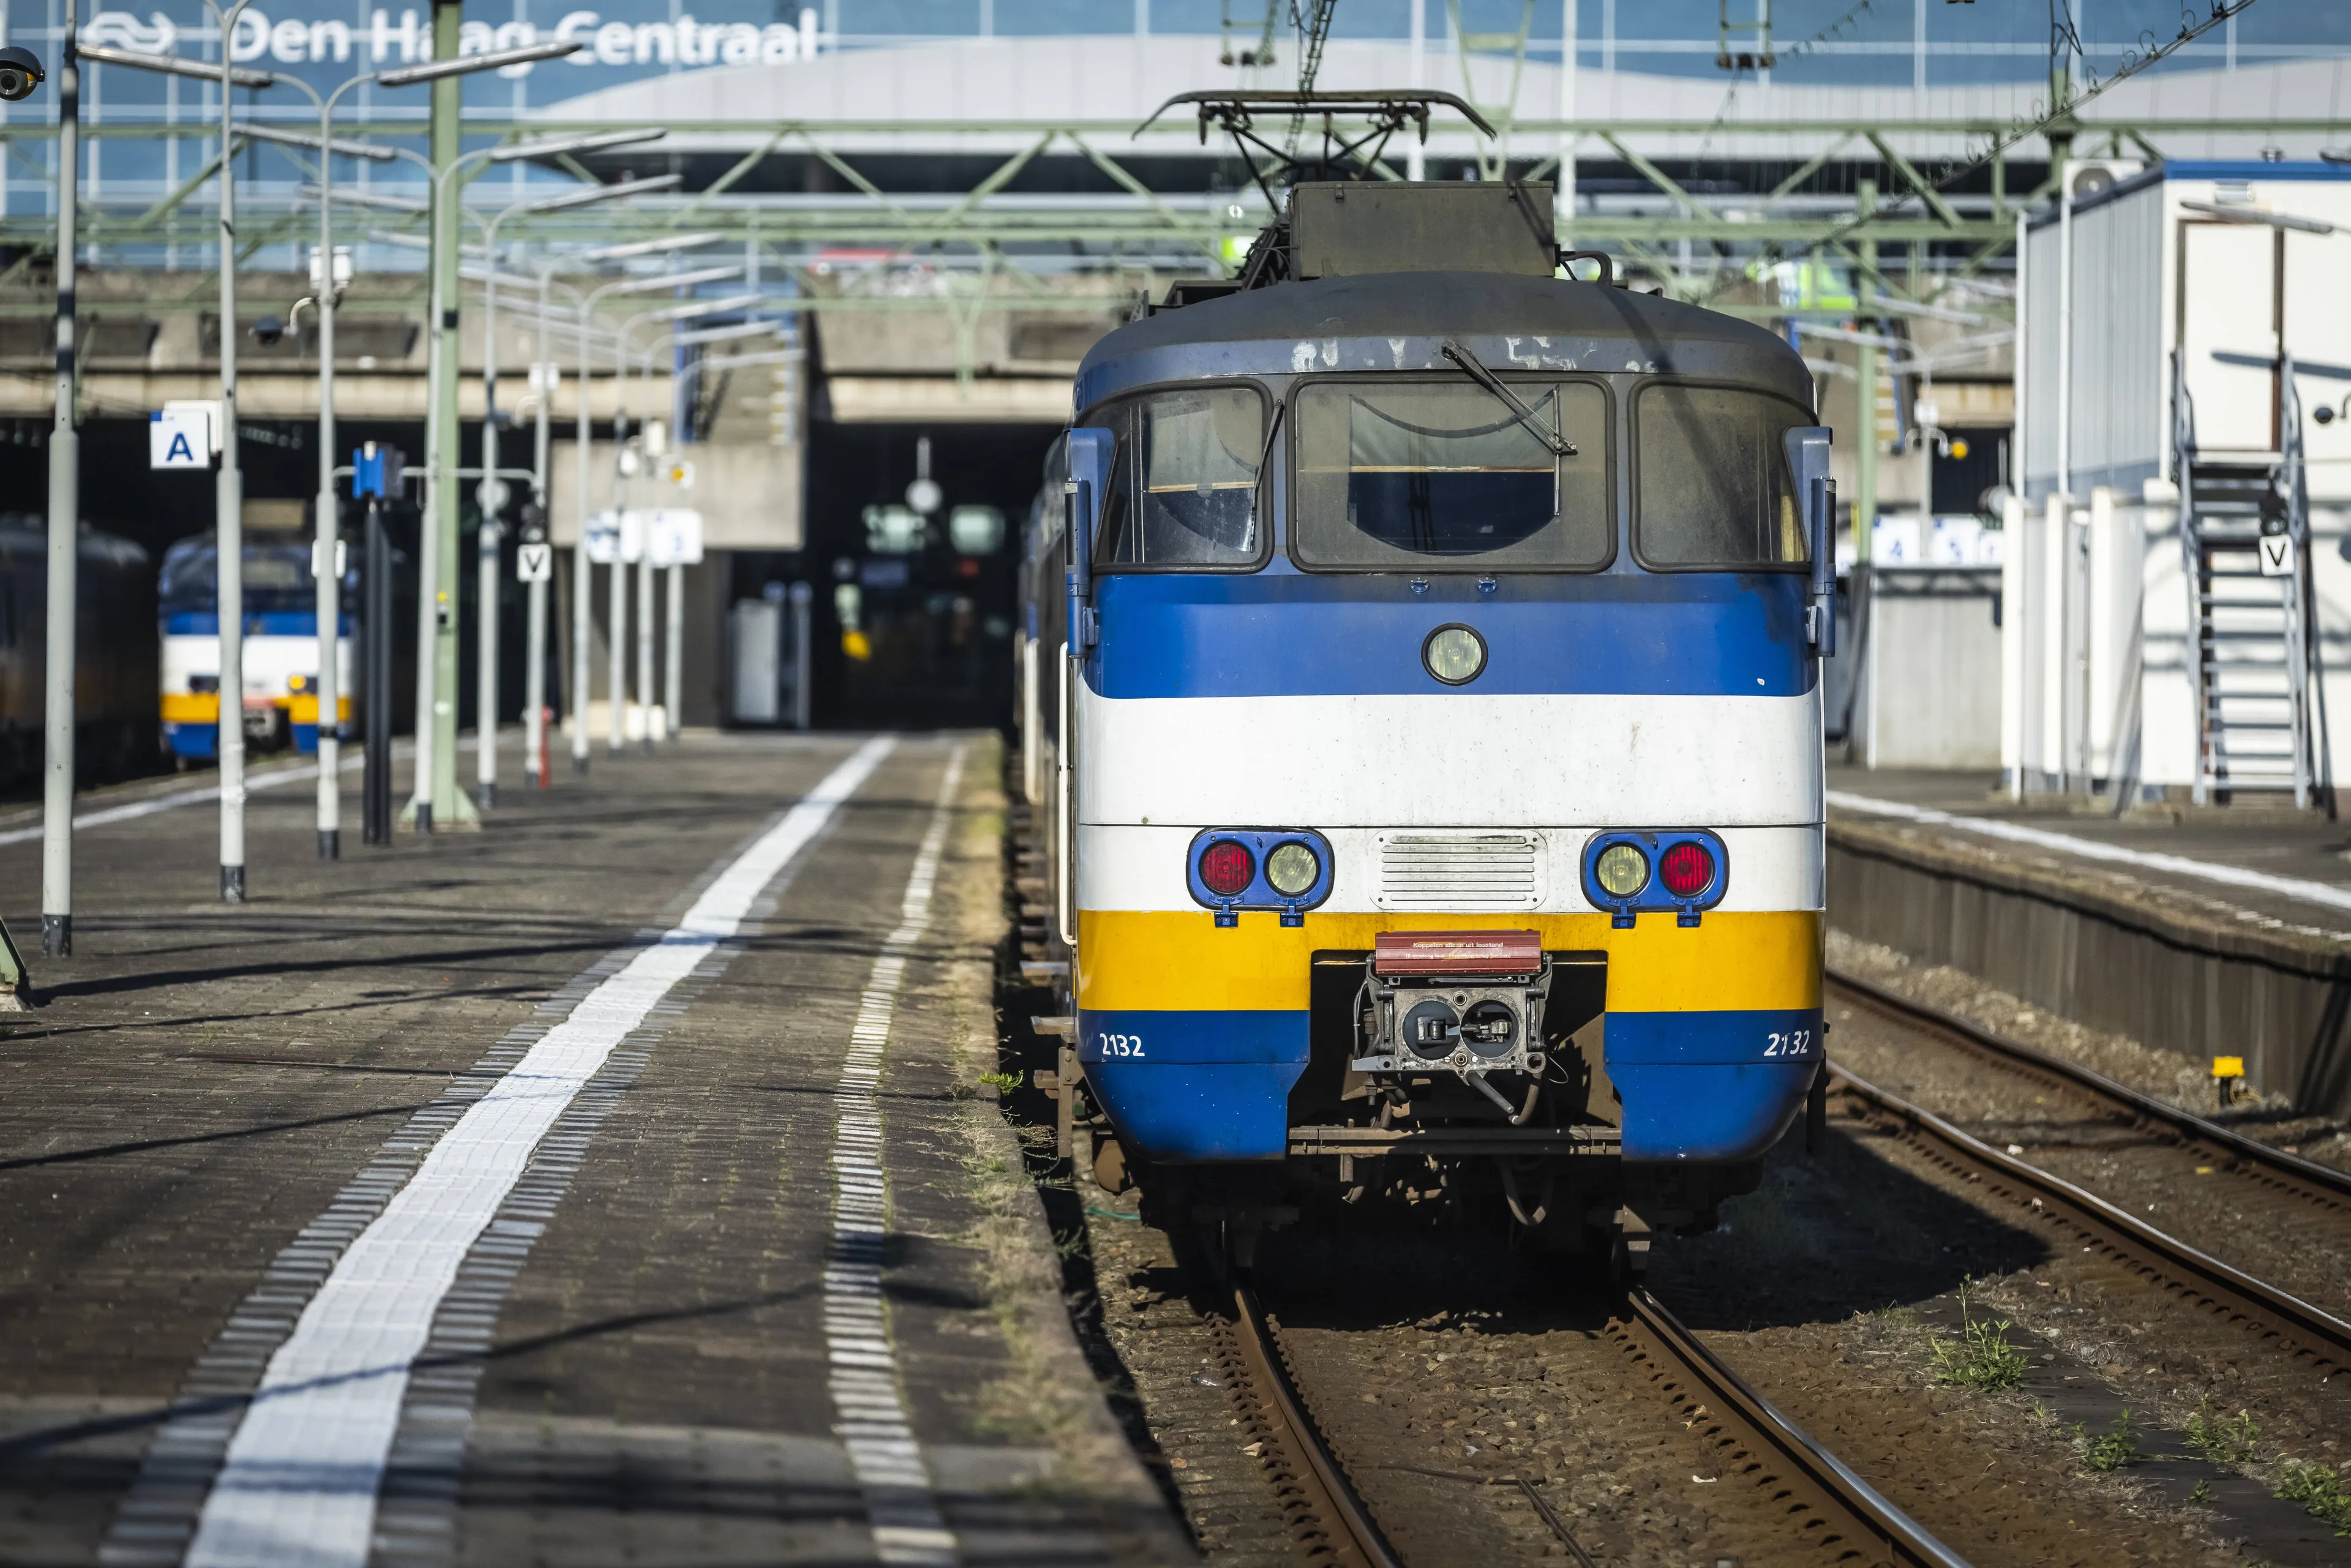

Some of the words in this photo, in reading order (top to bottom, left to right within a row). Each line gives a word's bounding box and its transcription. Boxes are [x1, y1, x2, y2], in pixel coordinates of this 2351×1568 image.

[224, 7, 350, 62] Den
[555, 7, 817, 66] Centraal
[166, 431, 193, 461] A
[525, 552, 544, 572] V
[2267, 543, 2285, 566] V
[1100, 1033, 1145, 1056] 2132
[1764, 1030, 1810, 1056] 2132
